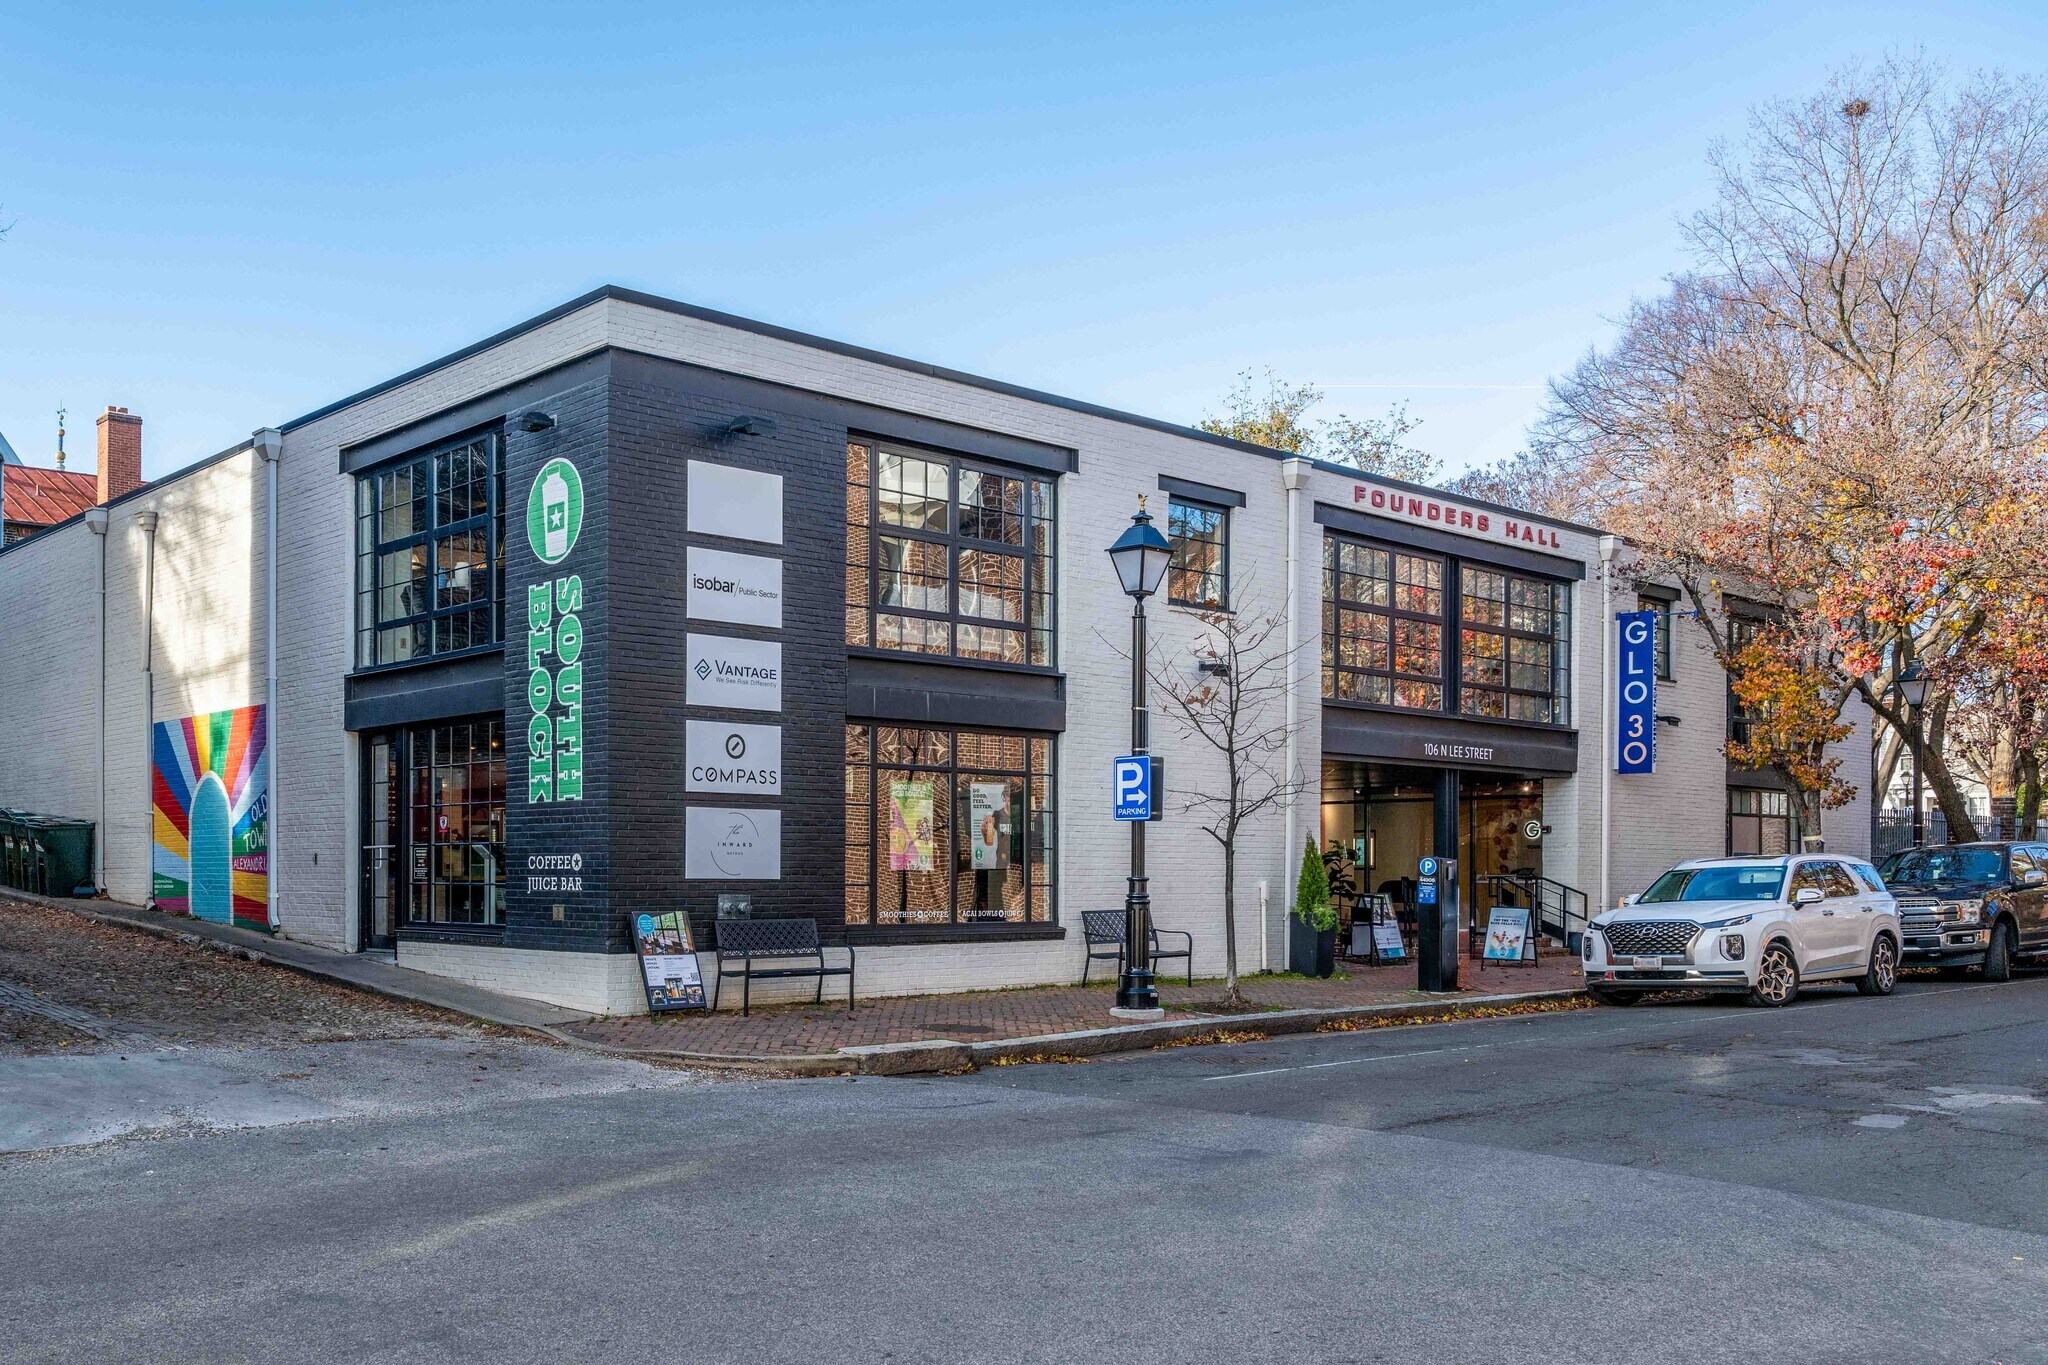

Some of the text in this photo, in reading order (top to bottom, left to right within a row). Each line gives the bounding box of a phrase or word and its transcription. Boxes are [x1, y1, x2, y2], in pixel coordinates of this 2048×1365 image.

[1354, 485, 1560, 548] FOUNDERS HALL
[739, 587, 757, 597] Public
[759, 589, 778, 599] Sector
[528, 581, 552, 803] BLOCK
[556, 575, 583, 800] SOUTH
[750, 680, 778, 689] Differently
[1424, 743, 1494, 760] 106 N LEE STREET
[692, 766, 777, 785] COMPASS
[1117, 762, 1143, 805] P
[251, 795, 267, 821] OLD
[1117, 807, 1147, 816] PARKING
[233, 857, 267, 871] ALEXANDRI
[528, 855, 571, 869] COFFEE
[527, 877, 583, 894] JUICE BAR
[924, 910, 949, 918] COFFEE
